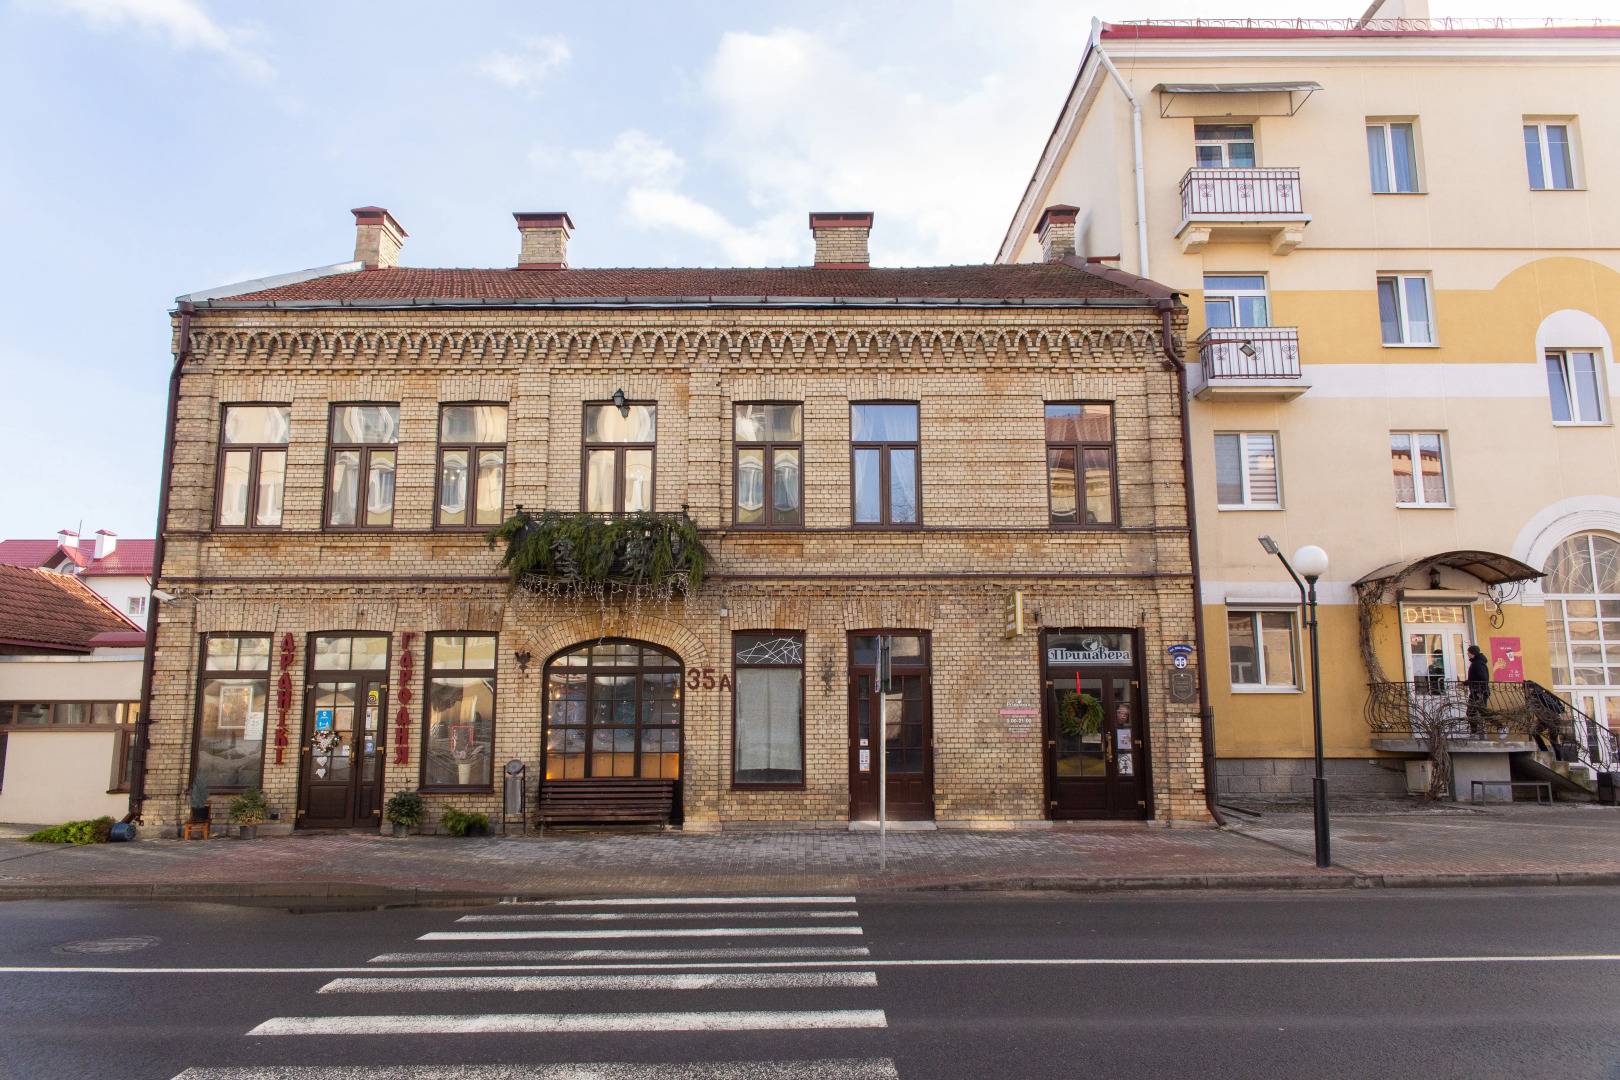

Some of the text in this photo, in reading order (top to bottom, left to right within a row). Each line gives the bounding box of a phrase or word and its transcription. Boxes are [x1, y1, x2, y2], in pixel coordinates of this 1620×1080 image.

[1406, 608, 1457, 623] DELI
[1048, 647, 1132, 660] Примавера
[394, 632, 414, 764] ГАРОДНЯ
